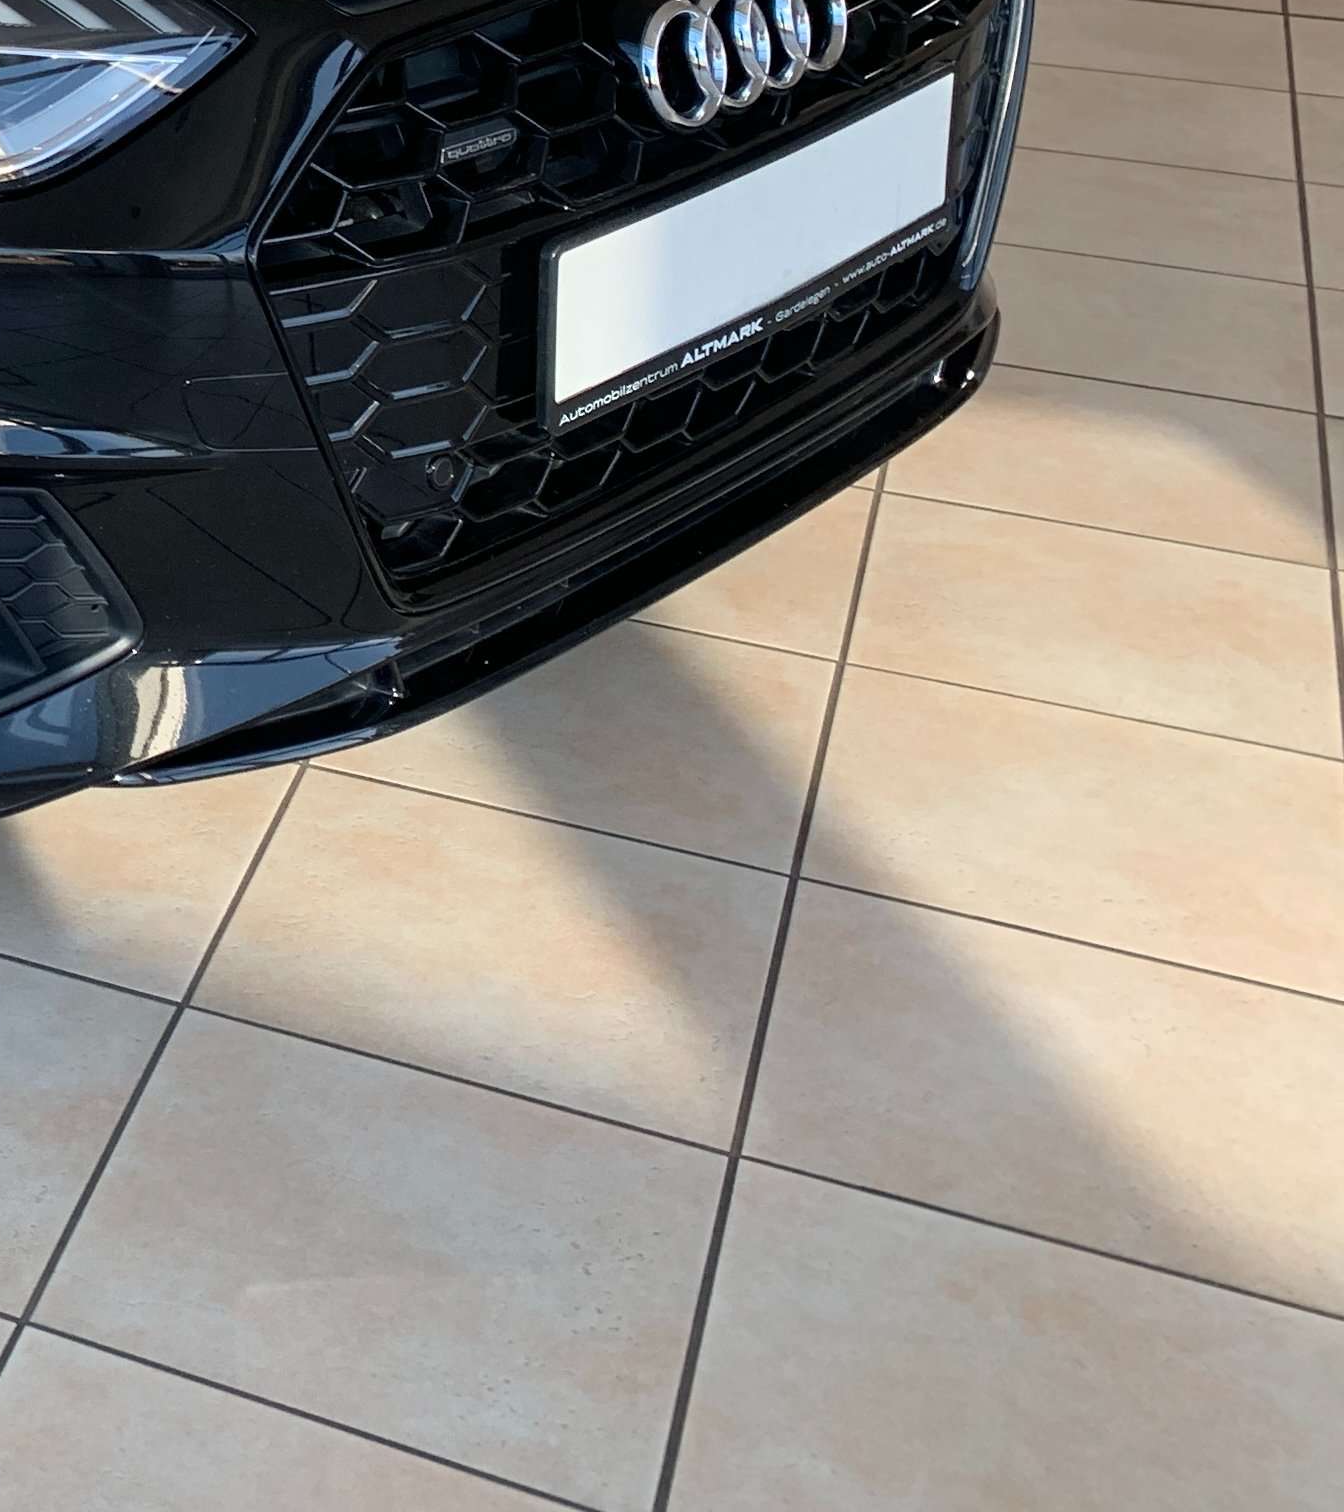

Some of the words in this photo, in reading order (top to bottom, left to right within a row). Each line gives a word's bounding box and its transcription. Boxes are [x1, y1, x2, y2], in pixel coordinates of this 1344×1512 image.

[447, 133, 513, 159] quattro
[559, 361, 679, 427] Automobilzentrum
[680, 317, 764, 368] ALTMARK
